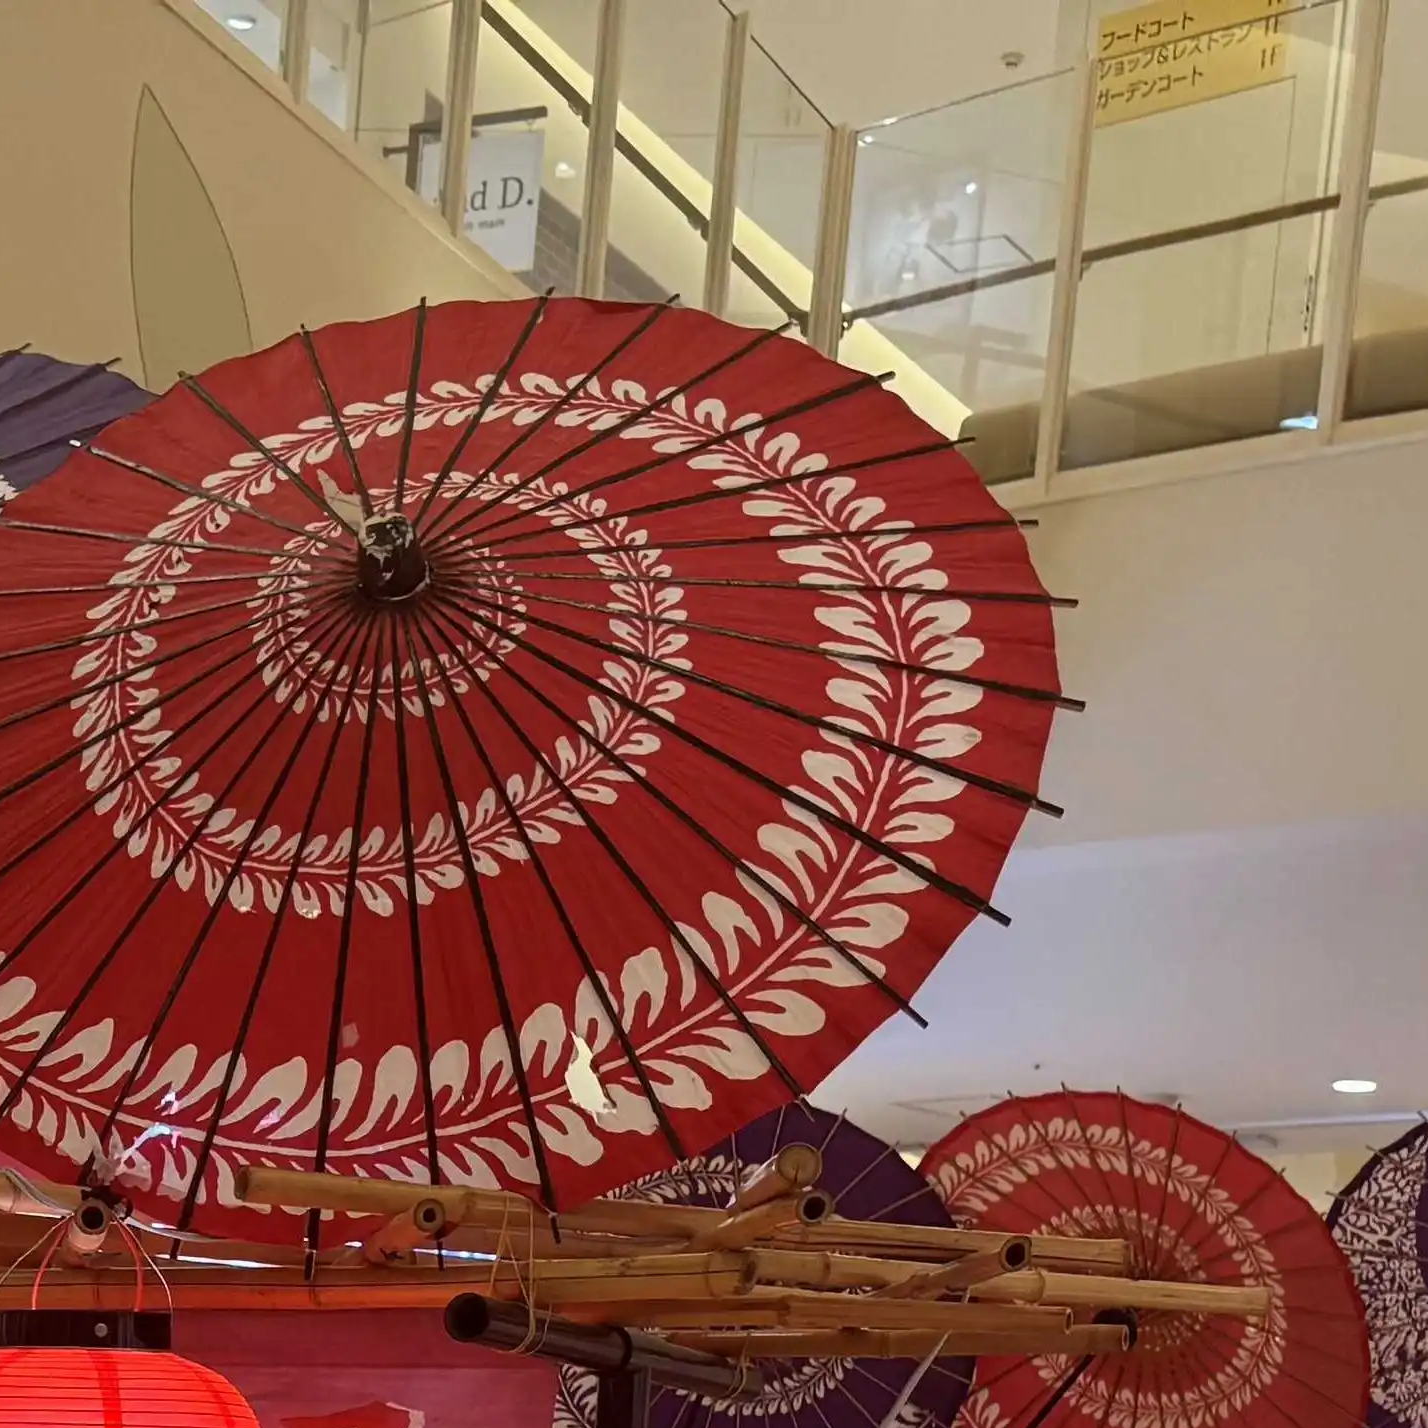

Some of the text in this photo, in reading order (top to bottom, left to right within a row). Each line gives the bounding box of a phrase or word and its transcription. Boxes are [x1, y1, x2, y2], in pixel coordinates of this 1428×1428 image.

[1103, 12, 1194, 50] フードコート
